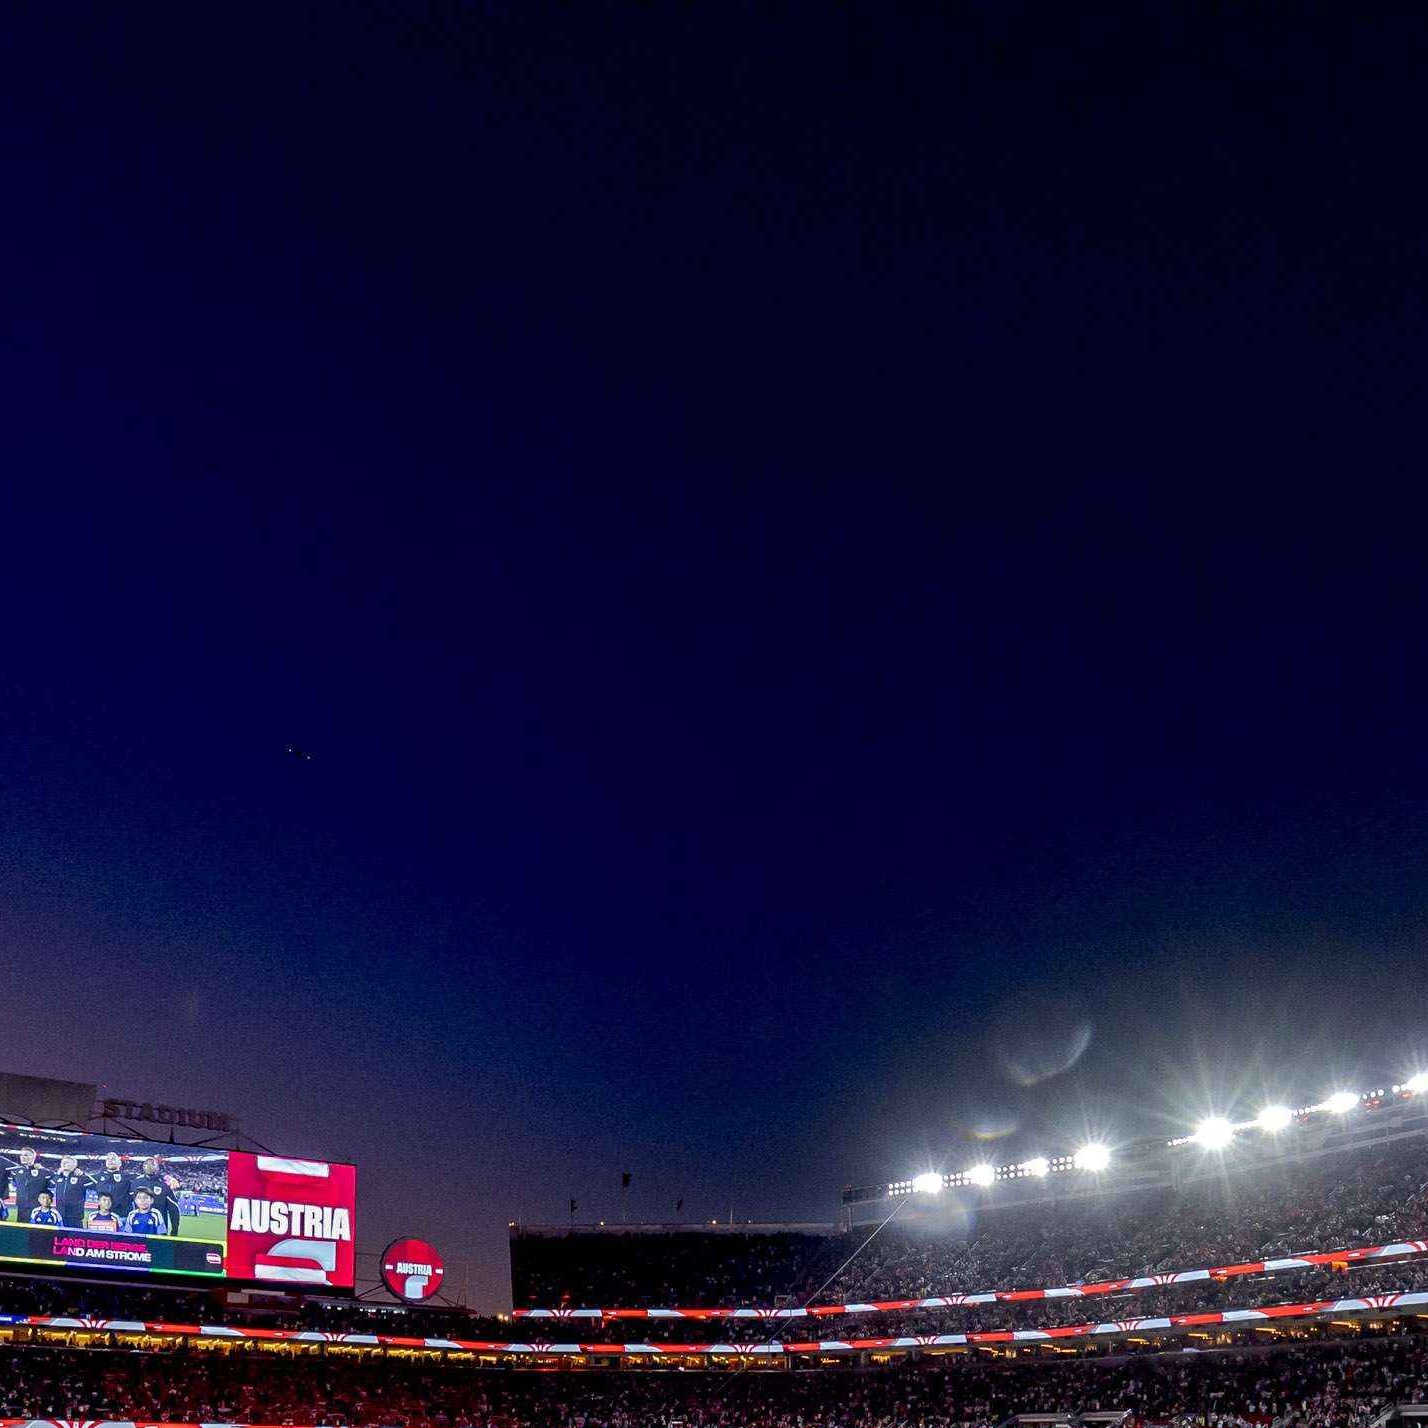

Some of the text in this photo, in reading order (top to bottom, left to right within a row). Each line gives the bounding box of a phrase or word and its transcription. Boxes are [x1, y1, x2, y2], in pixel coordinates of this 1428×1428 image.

[230, 1197, 351, 1241] AUSTRIA
[53, 1246, 85, 1257] LAND
[86, 1248, 105, 1258] AM
[396, 1262, 432, 1276] AUSTRIA
